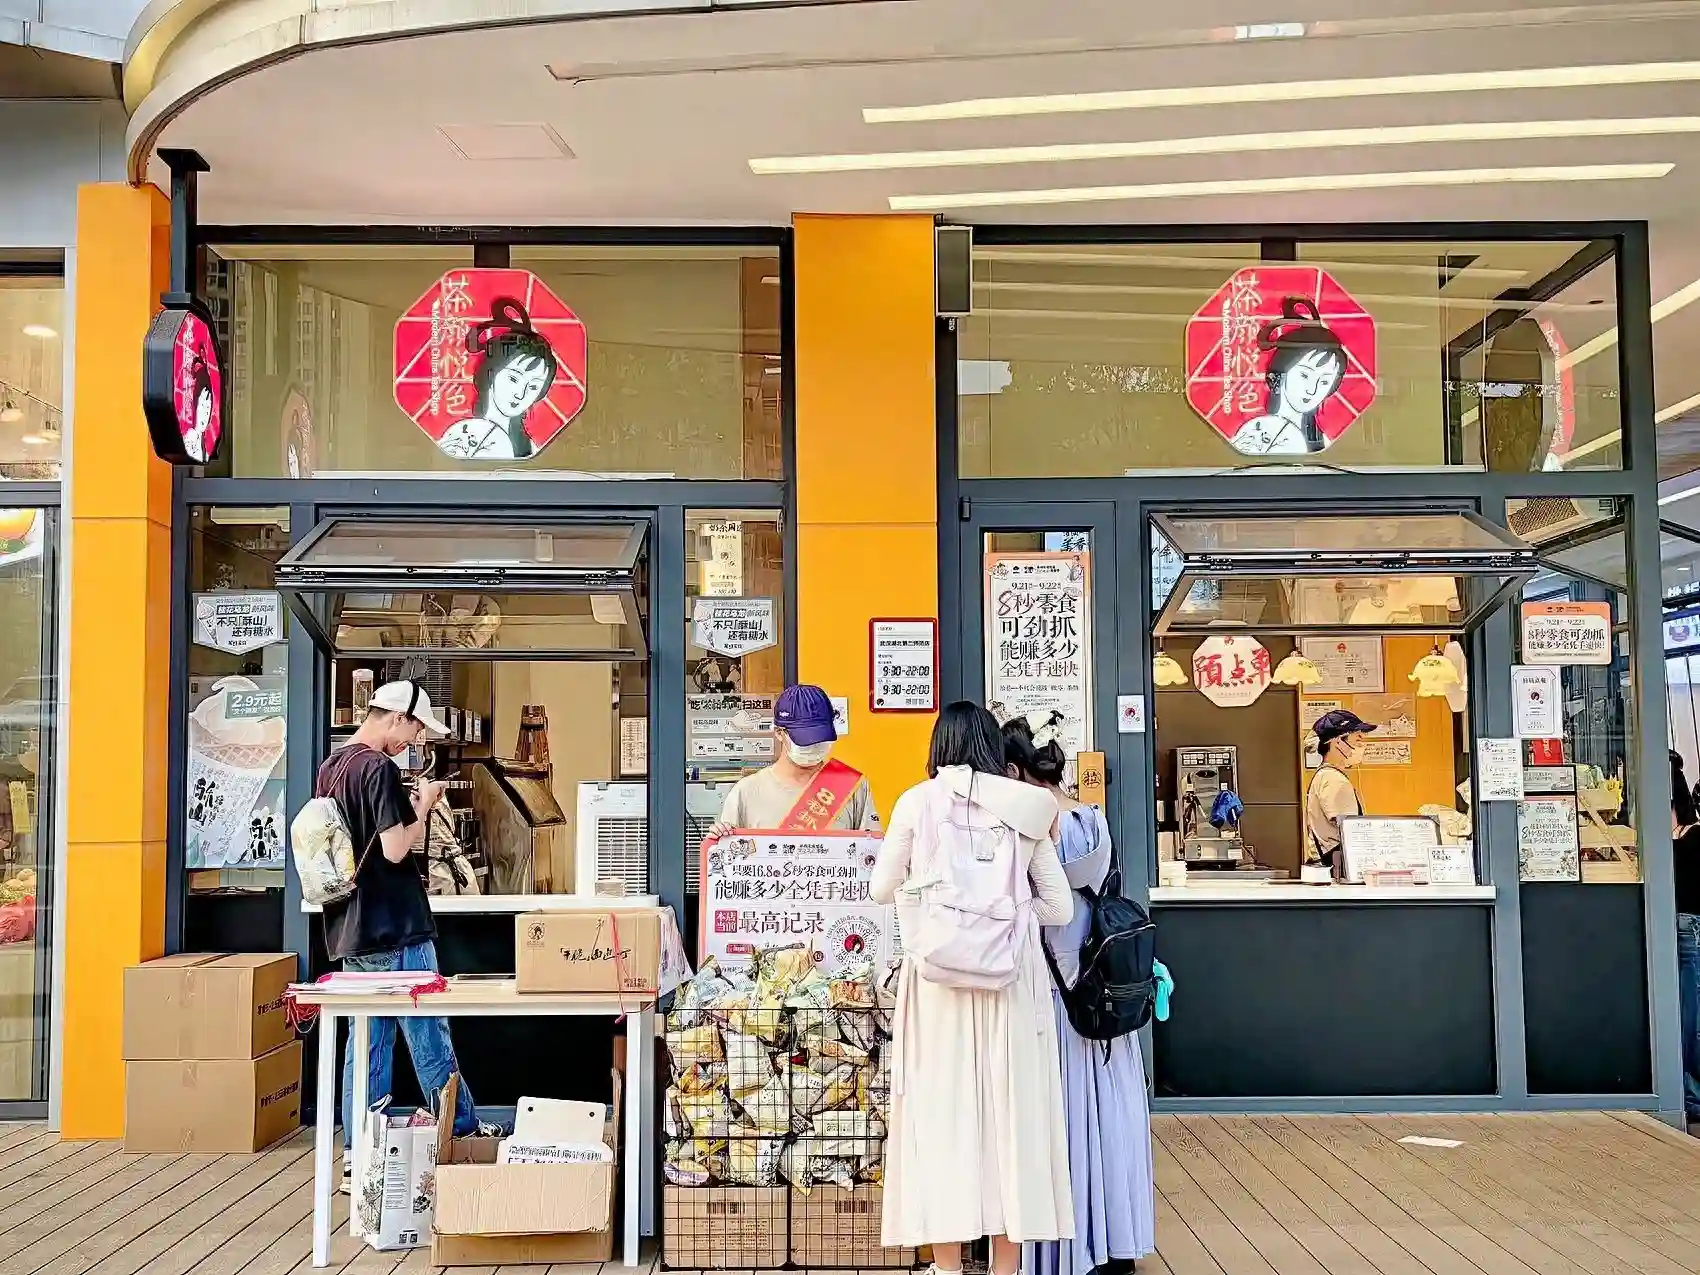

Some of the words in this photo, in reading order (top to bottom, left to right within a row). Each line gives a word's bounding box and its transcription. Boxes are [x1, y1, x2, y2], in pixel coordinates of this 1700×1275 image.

[998, 590, 1078, 616] 8秒零食
[231, 626, 274, 637] 还有糖水
[728, 630, 769, 640] 还有糖水
[998, 615, 1077, 638] 可劲抓
[1528, 628, 1605, 641] 8秒零食可劲抓
[1000, 639, 1078, 661] 能赚多少
[1000, 661, 1079, 678] 全凭手速快
[882, 684, 930, 695] 9:30-22:00
[231, 691, 282, 708] 2.9元起
[738, 910, 825, 934] 最高记录
